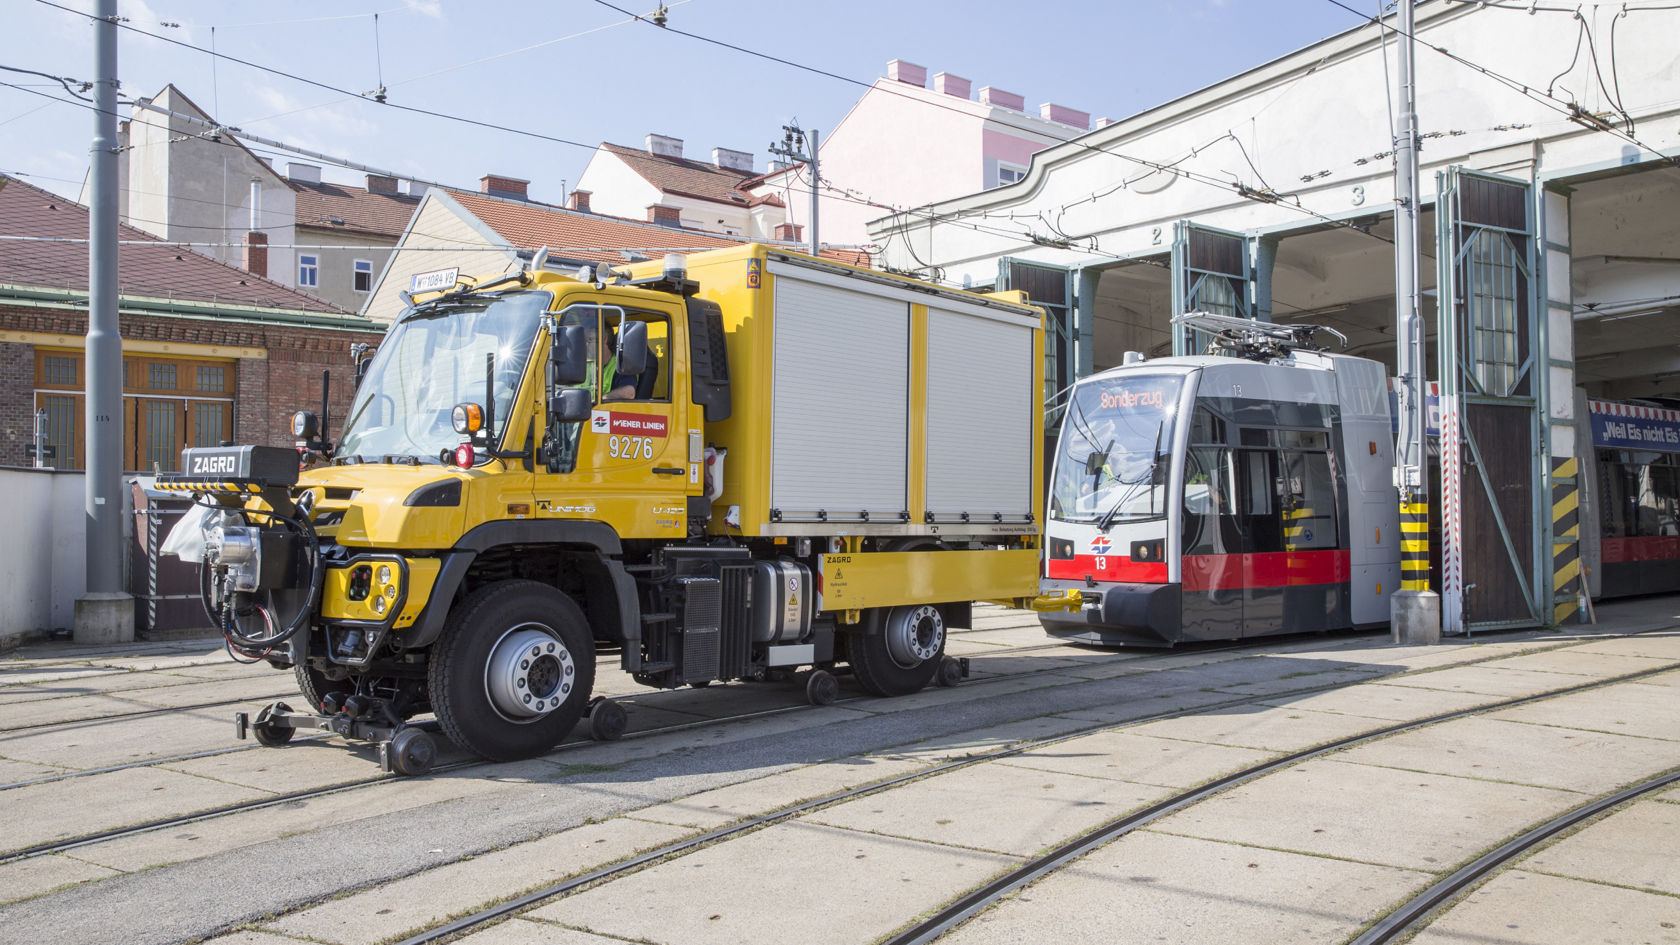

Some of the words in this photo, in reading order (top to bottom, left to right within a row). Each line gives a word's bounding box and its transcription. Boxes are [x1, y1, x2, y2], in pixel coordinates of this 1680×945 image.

[1351, 186, 1364, 206] 3
[1151, 226, 1162, 245] 2
[1101, 390, 1162, 408] Sonderzug
[1232, 384, 1242, 397] 13
[642, 421, 665, 430] LINIEN
[1627, 423, 1642, 441] Eis
[1643, 425, 1665, 443] nicht
[1665, 426, 1679, 443] Eis
[609, 435, 653, 460] 9276
[193, 456, 236, 473] ZAGRO
[827, 556, 852, 564] ZAGRO
[1094, 556, 1106, 570] 13
